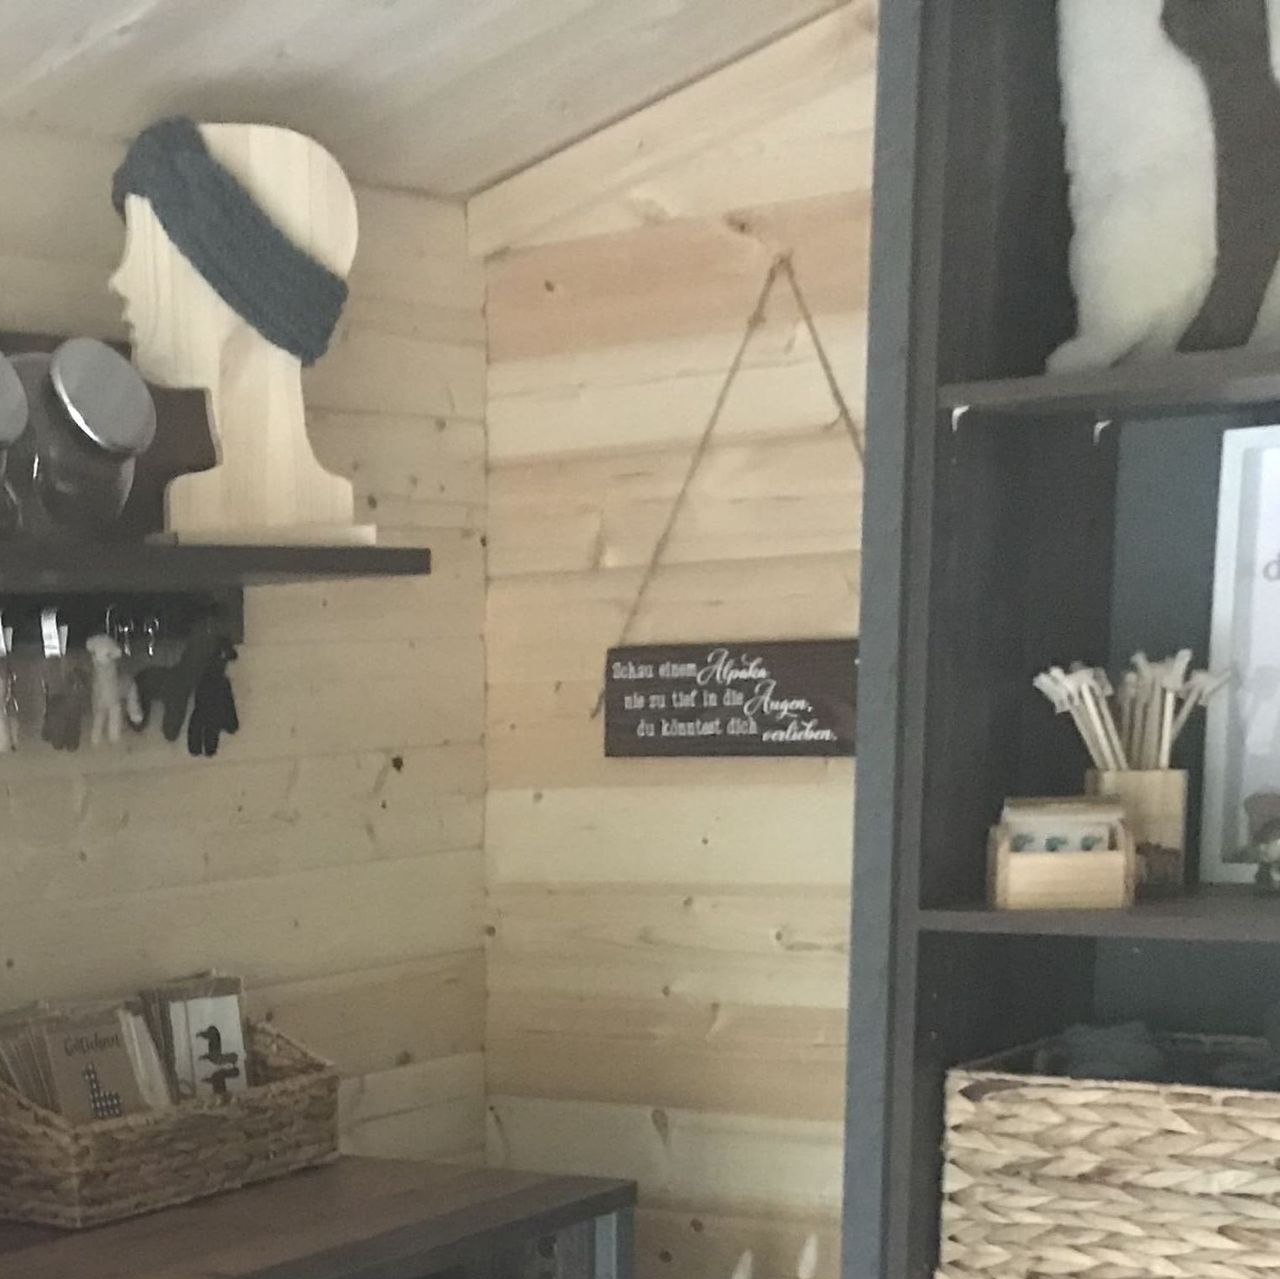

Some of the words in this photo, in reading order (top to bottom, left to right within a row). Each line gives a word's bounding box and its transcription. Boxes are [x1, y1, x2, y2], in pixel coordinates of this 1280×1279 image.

[612, 661, 654, 679] Schau
[658, 661, 697, 678] einem
[696, 648, 767, 685] Alpaka
[624, 689, 645, 710] nie
[649, 693, 666, 709] zu
[671, 689, 697, 709] tief
[702, 689, 717, 707] in
[722, 688, 744, 706] die
[743, 679, 812, 720] Augen,
[636, 719, 655, 737] du
[661, 718, 722, 737] könntest
[726, 717, 758, 735] dich
[762, 718, 838, 742] verlieben.
